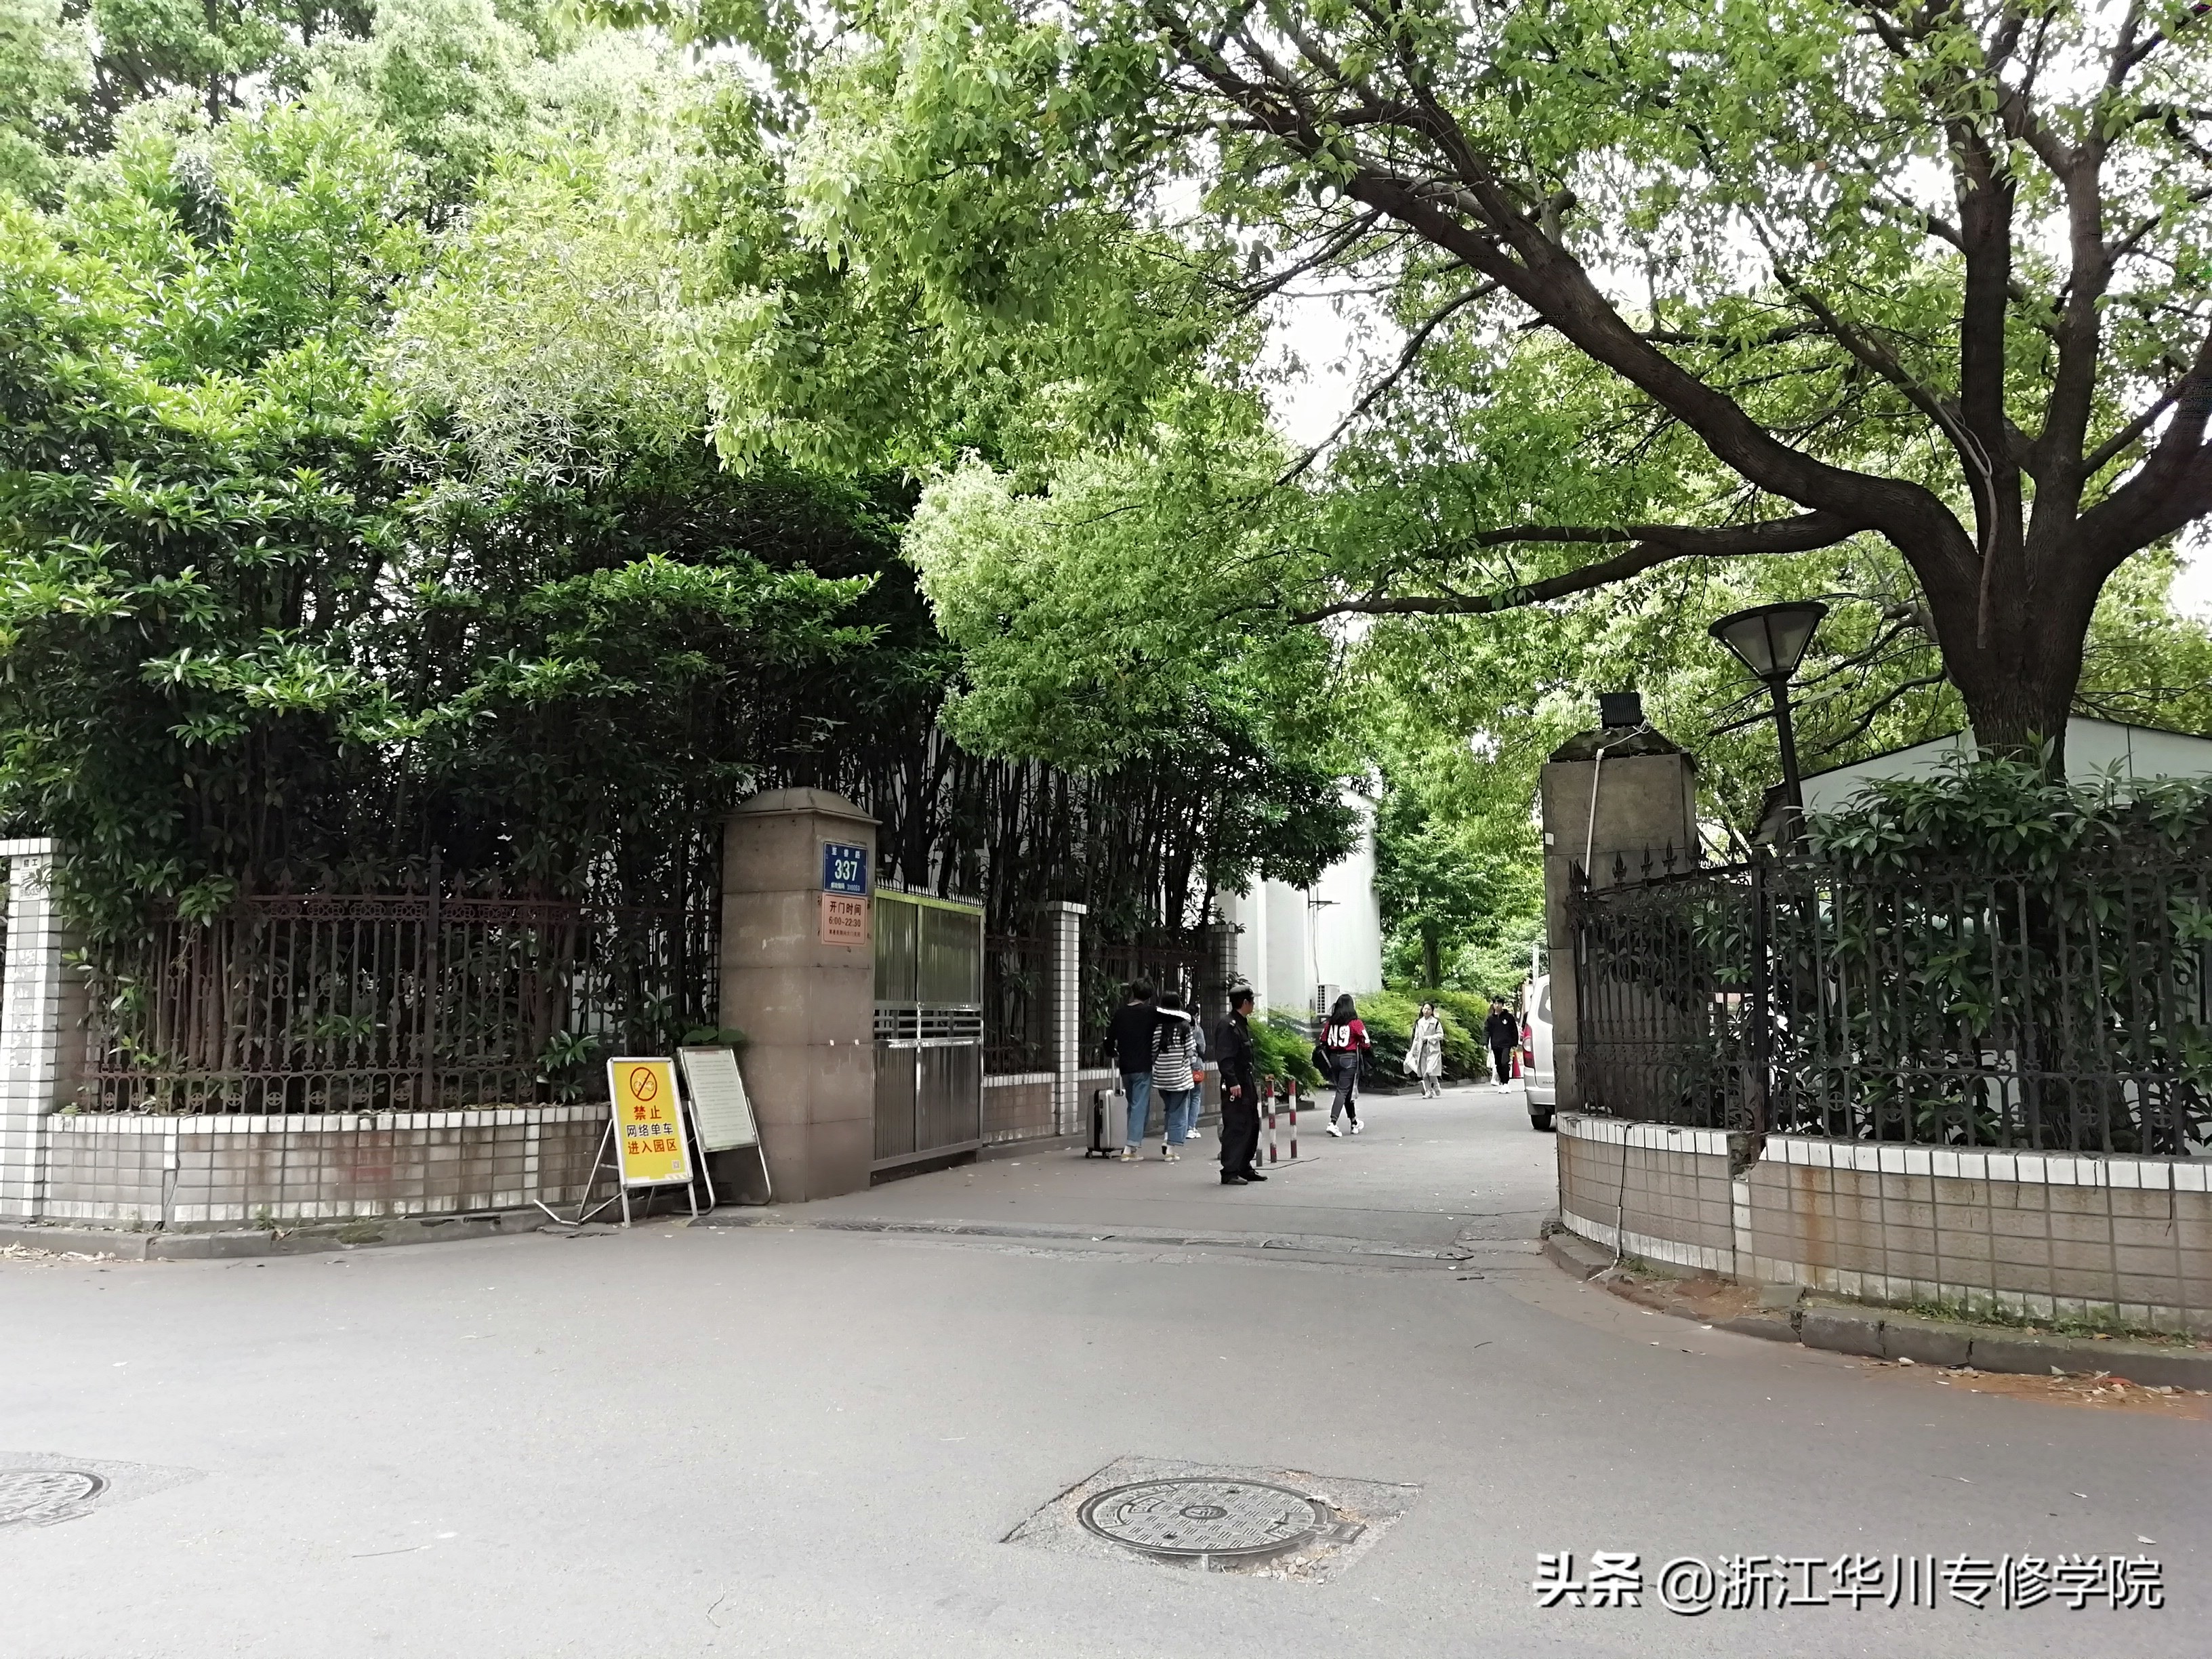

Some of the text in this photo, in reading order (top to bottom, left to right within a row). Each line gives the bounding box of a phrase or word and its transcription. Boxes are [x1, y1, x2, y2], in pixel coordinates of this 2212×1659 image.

[835, 859, 857, 881] 337
[830, 901, 861, 916] 开门时间
[634, 1105, 662, 1120] 禁止
[627, 1122, 673, 1137] 网络单车
[628, 1139, 677, 1155] 进入园区
